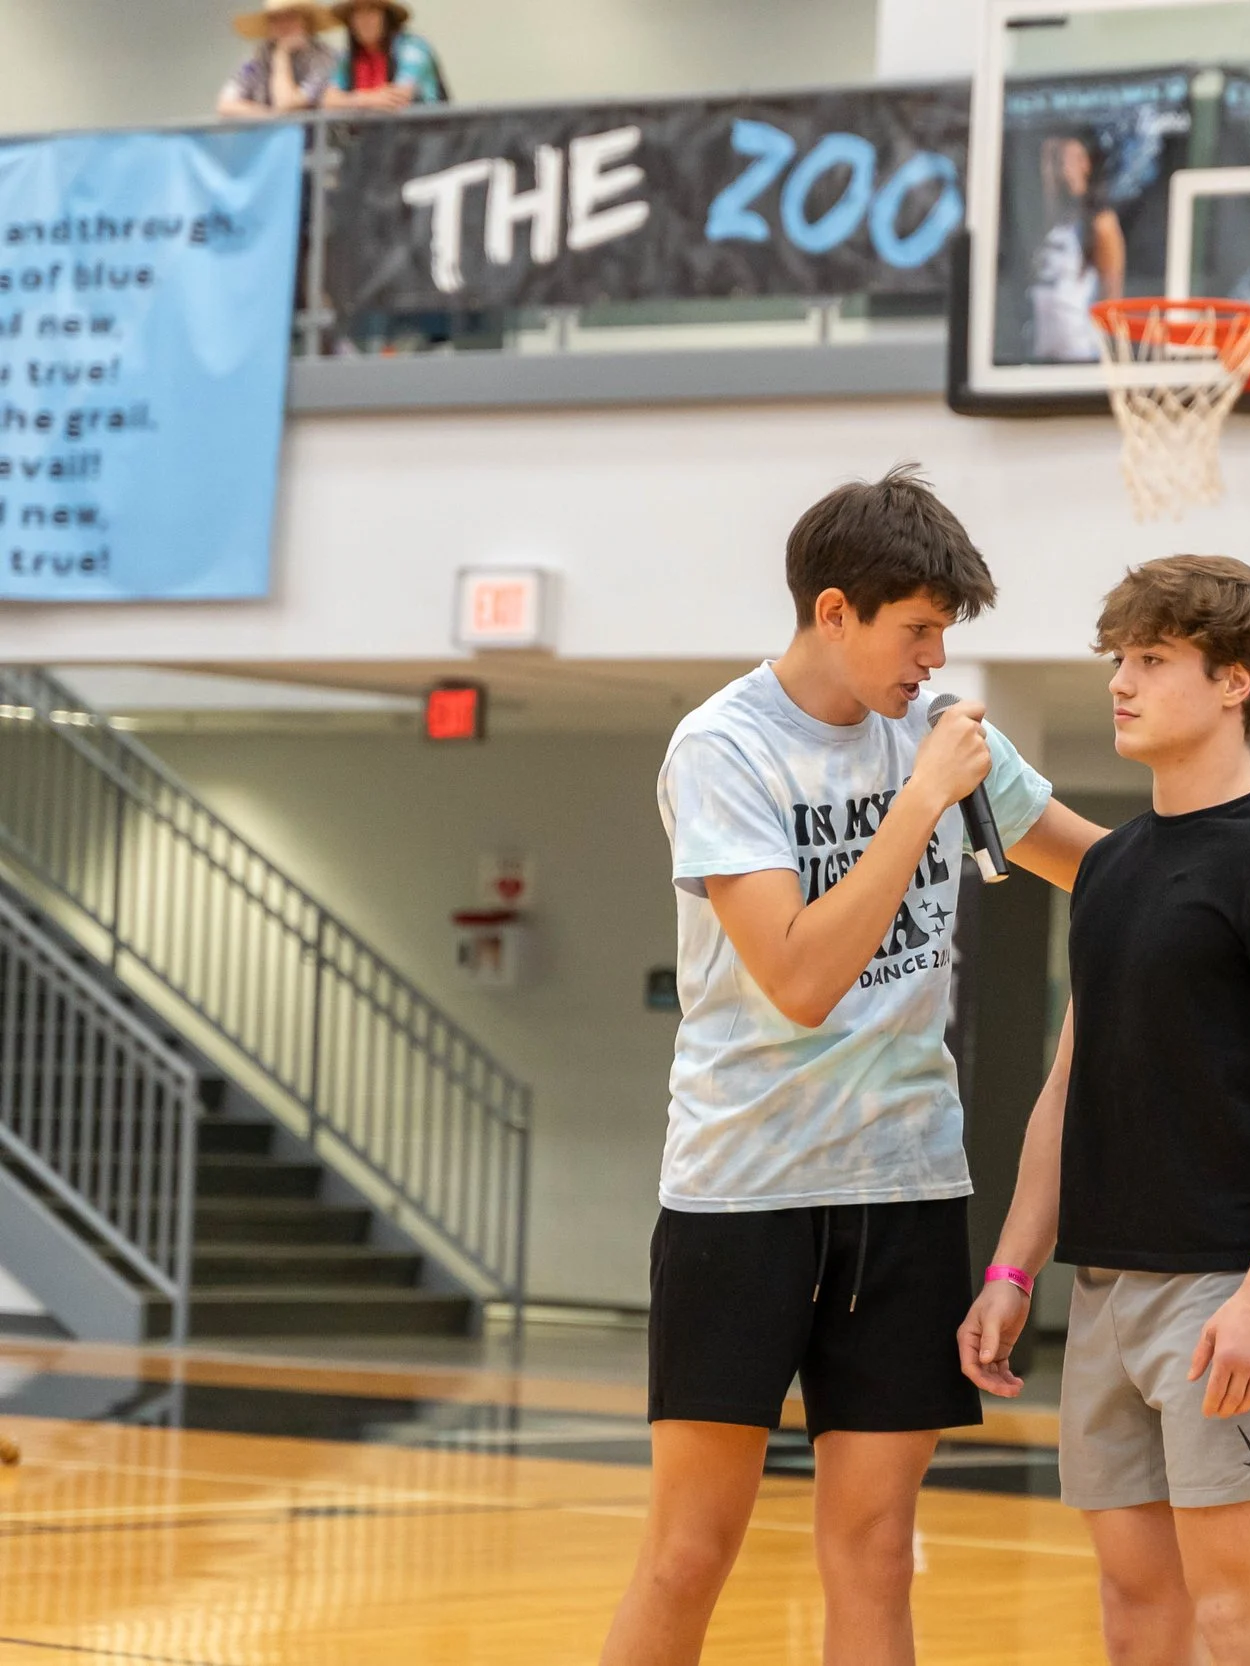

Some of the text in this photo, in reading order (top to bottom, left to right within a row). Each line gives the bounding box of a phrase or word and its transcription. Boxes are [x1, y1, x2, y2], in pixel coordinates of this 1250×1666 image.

[403, 119, 965, 293] THE ZOO
[792, 790, 897, 847] IN MY
[859, 953, 928, 989] DANCE
